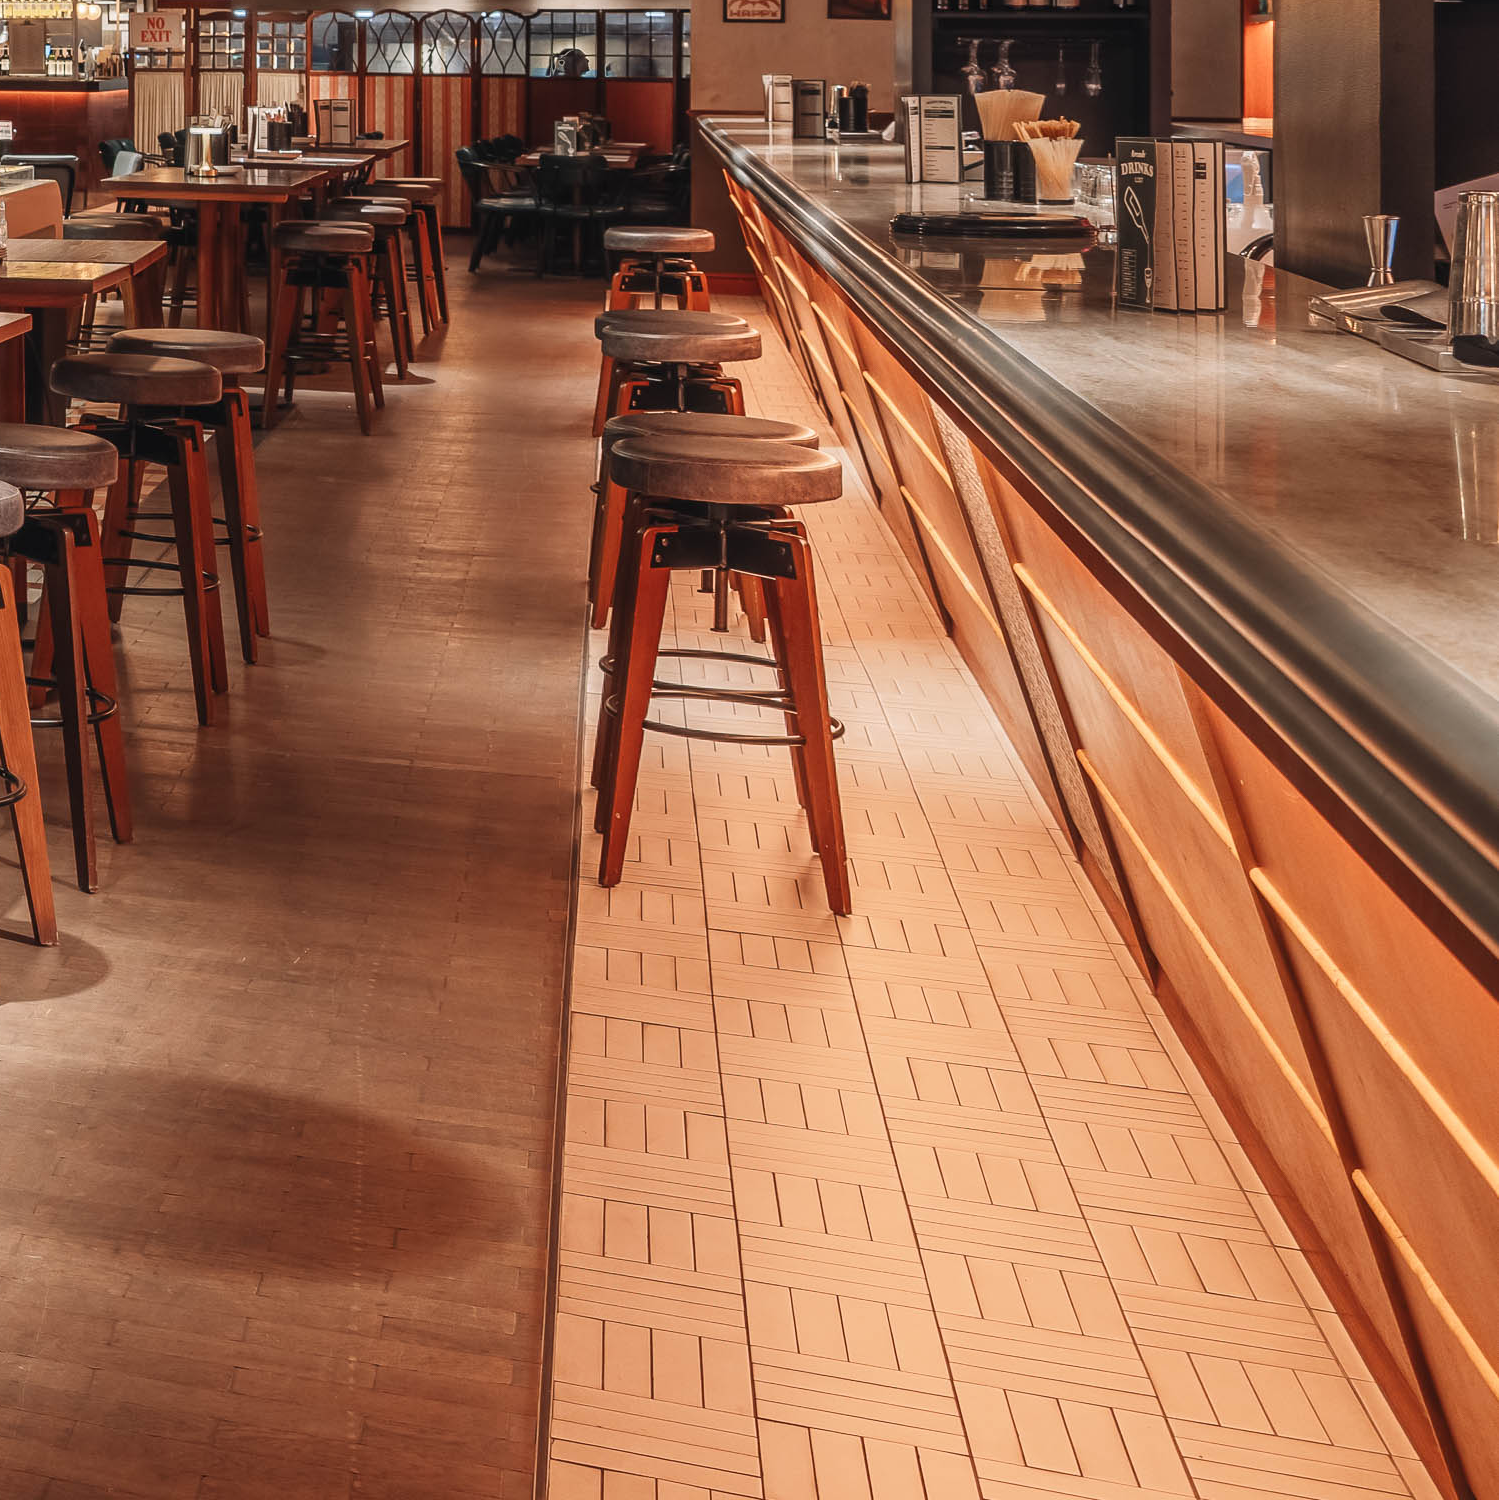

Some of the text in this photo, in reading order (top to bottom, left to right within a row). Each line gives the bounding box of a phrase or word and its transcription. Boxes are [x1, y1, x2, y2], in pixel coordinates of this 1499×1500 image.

[147, 16, 165, 30] NO
[141, 30, 172, 42] EXIT
[1121, 162, 1154, 178] DRINKS
